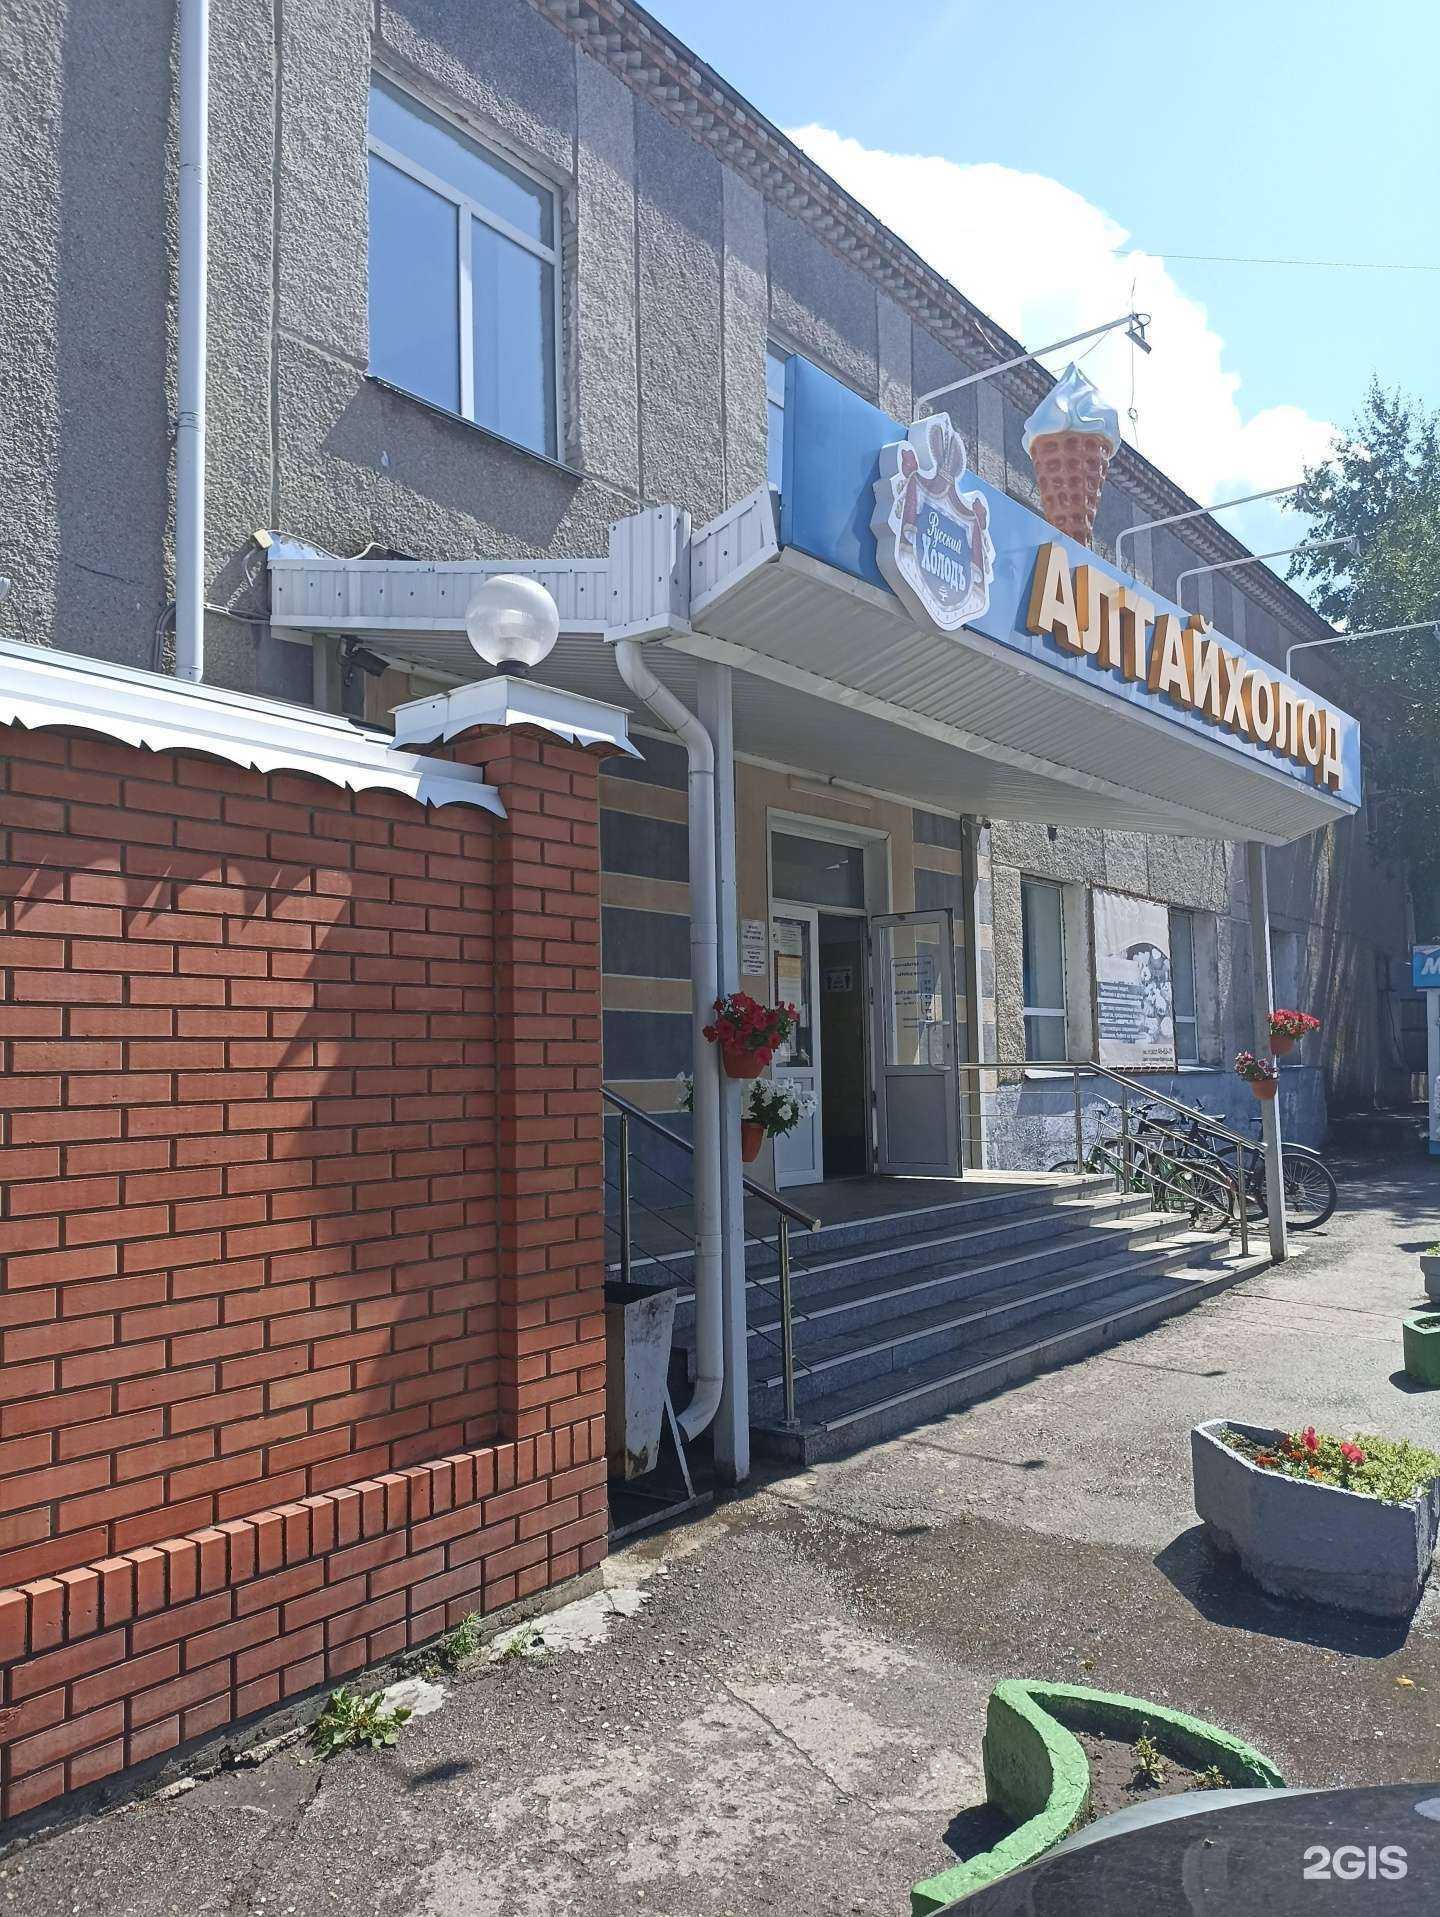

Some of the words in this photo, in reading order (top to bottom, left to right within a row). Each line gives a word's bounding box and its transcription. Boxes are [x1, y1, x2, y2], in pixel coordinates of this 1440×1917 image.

[927, 511, 962, 554] Русский
[921, 533, 966, 592] Холодъ
[1036, 542, 1343, 791] АЛТАЙХОЛОД
